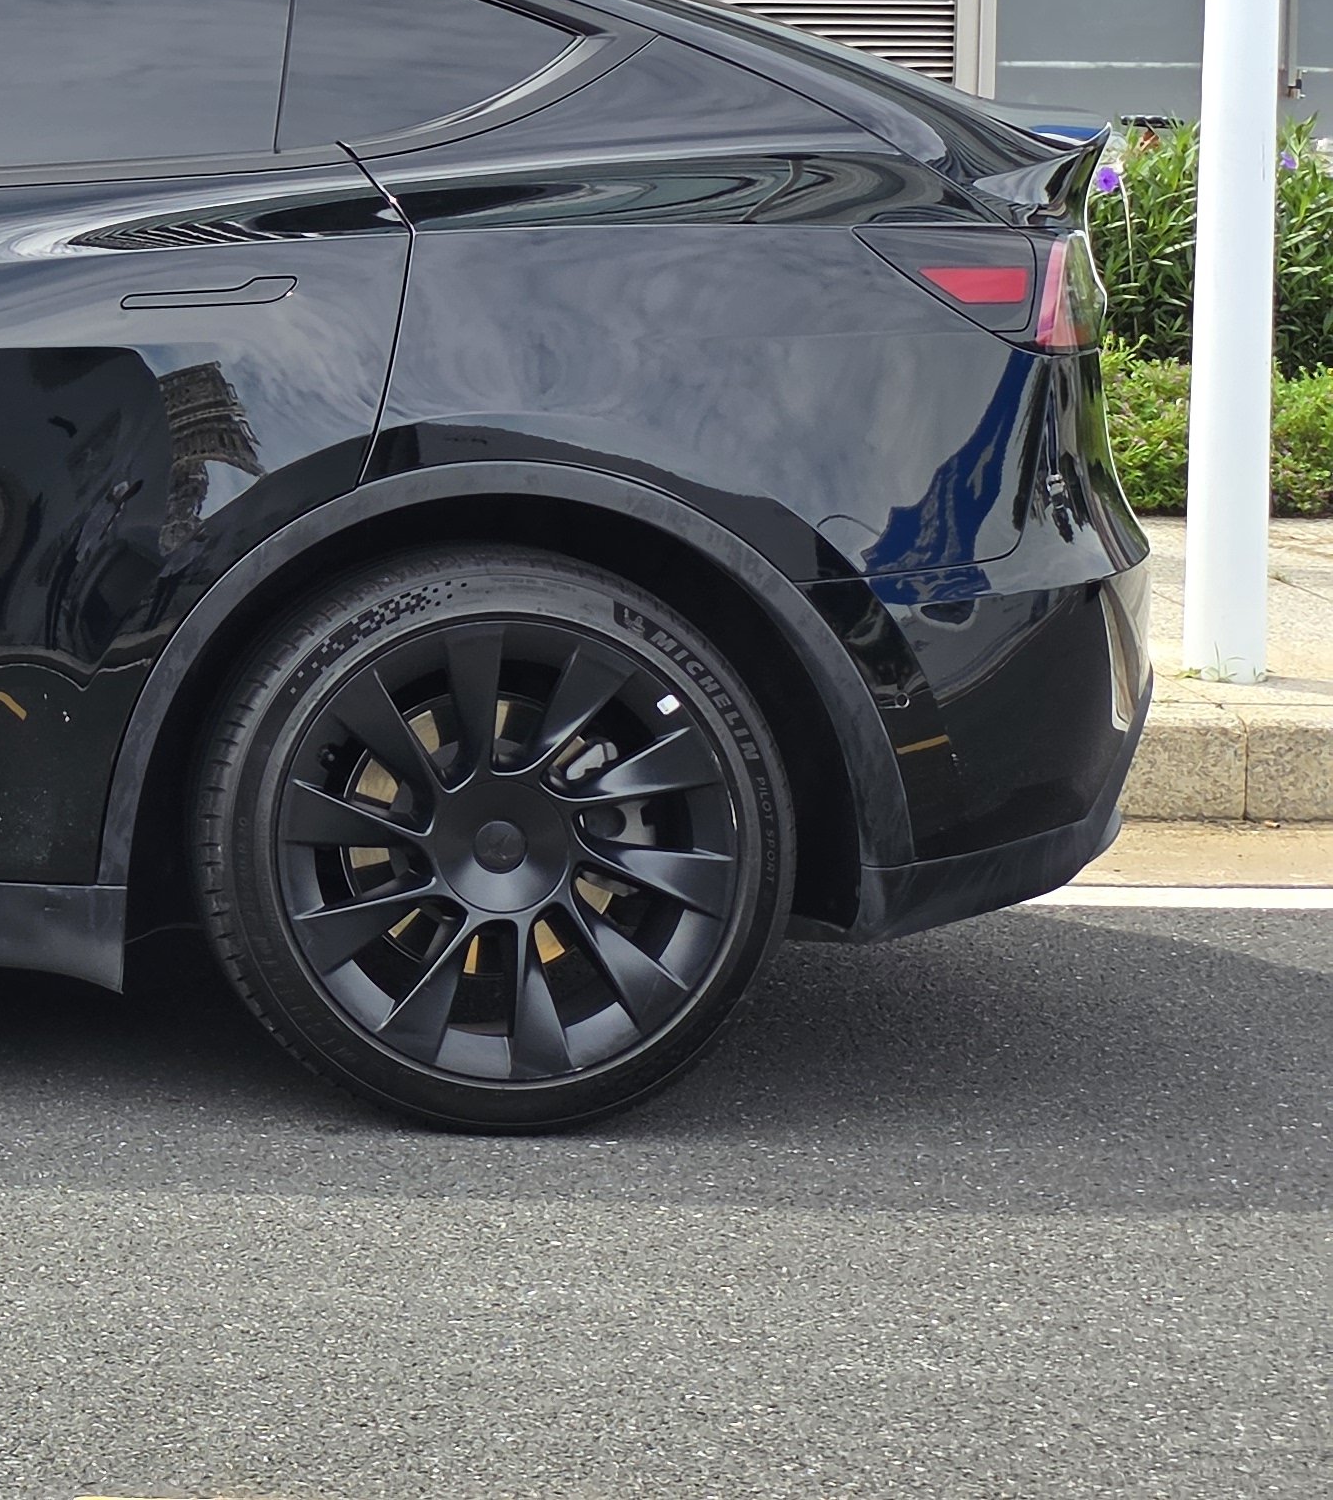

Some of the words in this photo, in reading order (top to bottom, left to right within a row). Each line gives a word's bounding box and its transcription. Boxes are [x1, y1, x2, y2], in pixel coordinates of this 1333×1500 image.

[650, 630, 760, 761] MICHELIN
[755, 776, 774, 822] PILOT
[763, 829, 782, 884] SPORT
